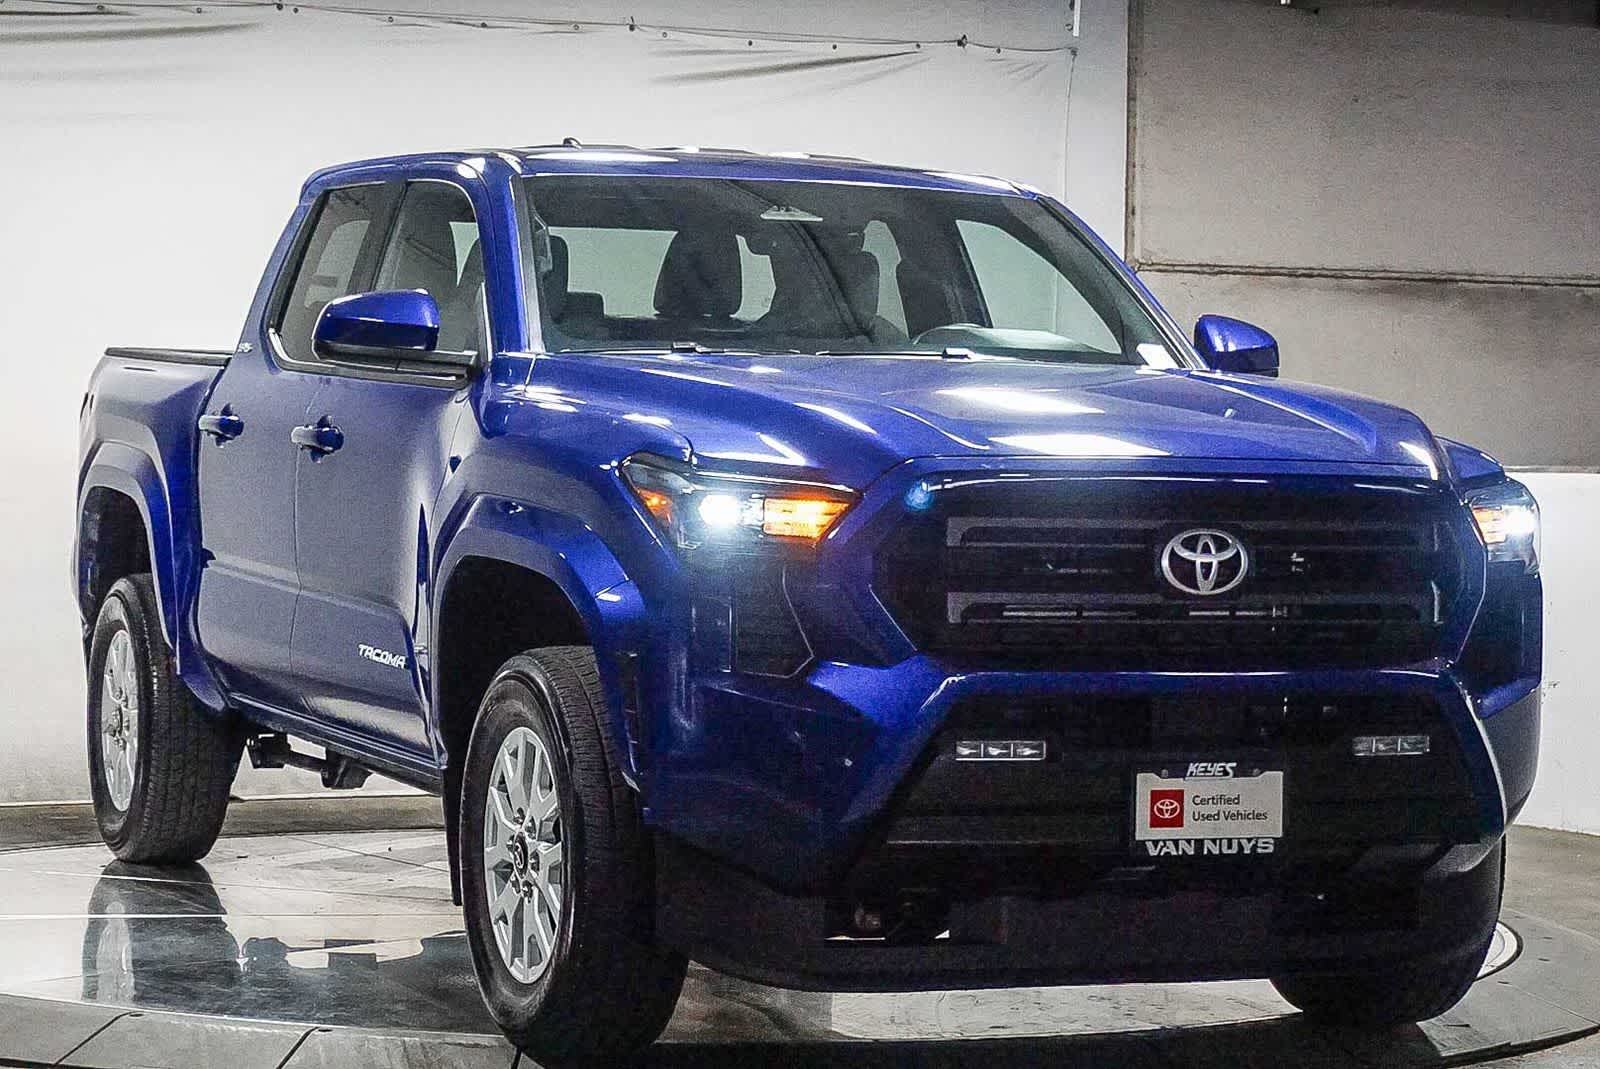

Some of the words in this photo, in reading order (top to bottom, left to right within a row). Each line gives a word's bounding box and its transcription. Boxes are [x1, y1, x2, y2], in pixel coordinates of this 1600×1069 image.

[358, 643, 406, 669] TACOMA
[1186, 762, 1237, 779] KEYES
[1192, 794, 1241, 806] Certified
[1192, 810, 1220, 822] Used
[1223, 809, 1268, 821] Vehicles
[1145, 839, 1195, 856] VAN
[1203, 838, 1275, 855] NUYS
